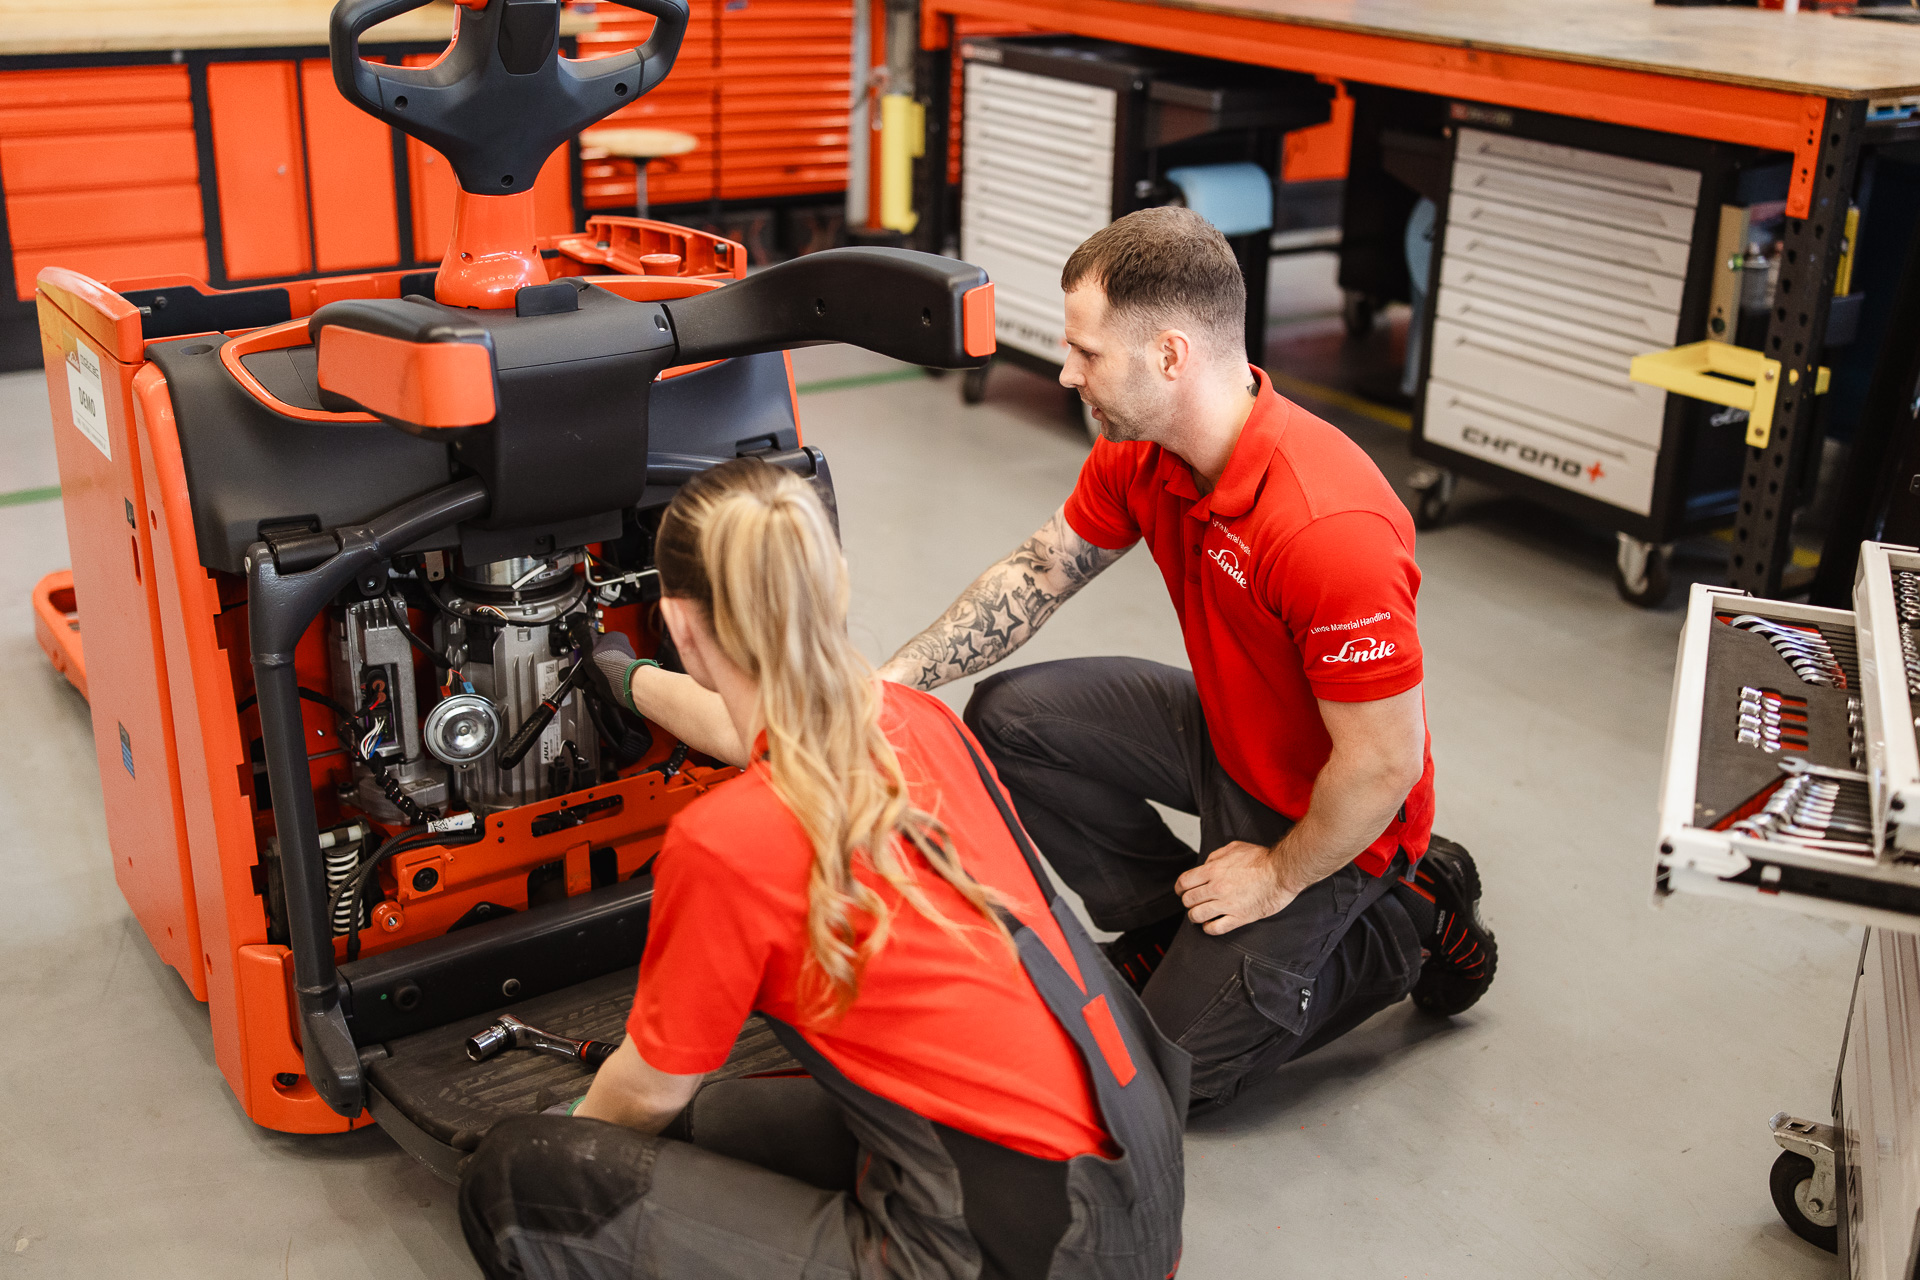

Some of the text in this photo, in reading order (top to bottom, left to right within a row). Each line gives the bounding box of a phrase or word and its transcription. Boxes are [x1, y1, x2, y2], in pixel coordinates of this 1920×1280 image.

[78, 386, 96, 417] DEMO
[1207, 549, 1247, 589] Linde
[1310, 611, 1391, 635] Linde Material Handling
[1322, 637, 1396, 663] Linde
